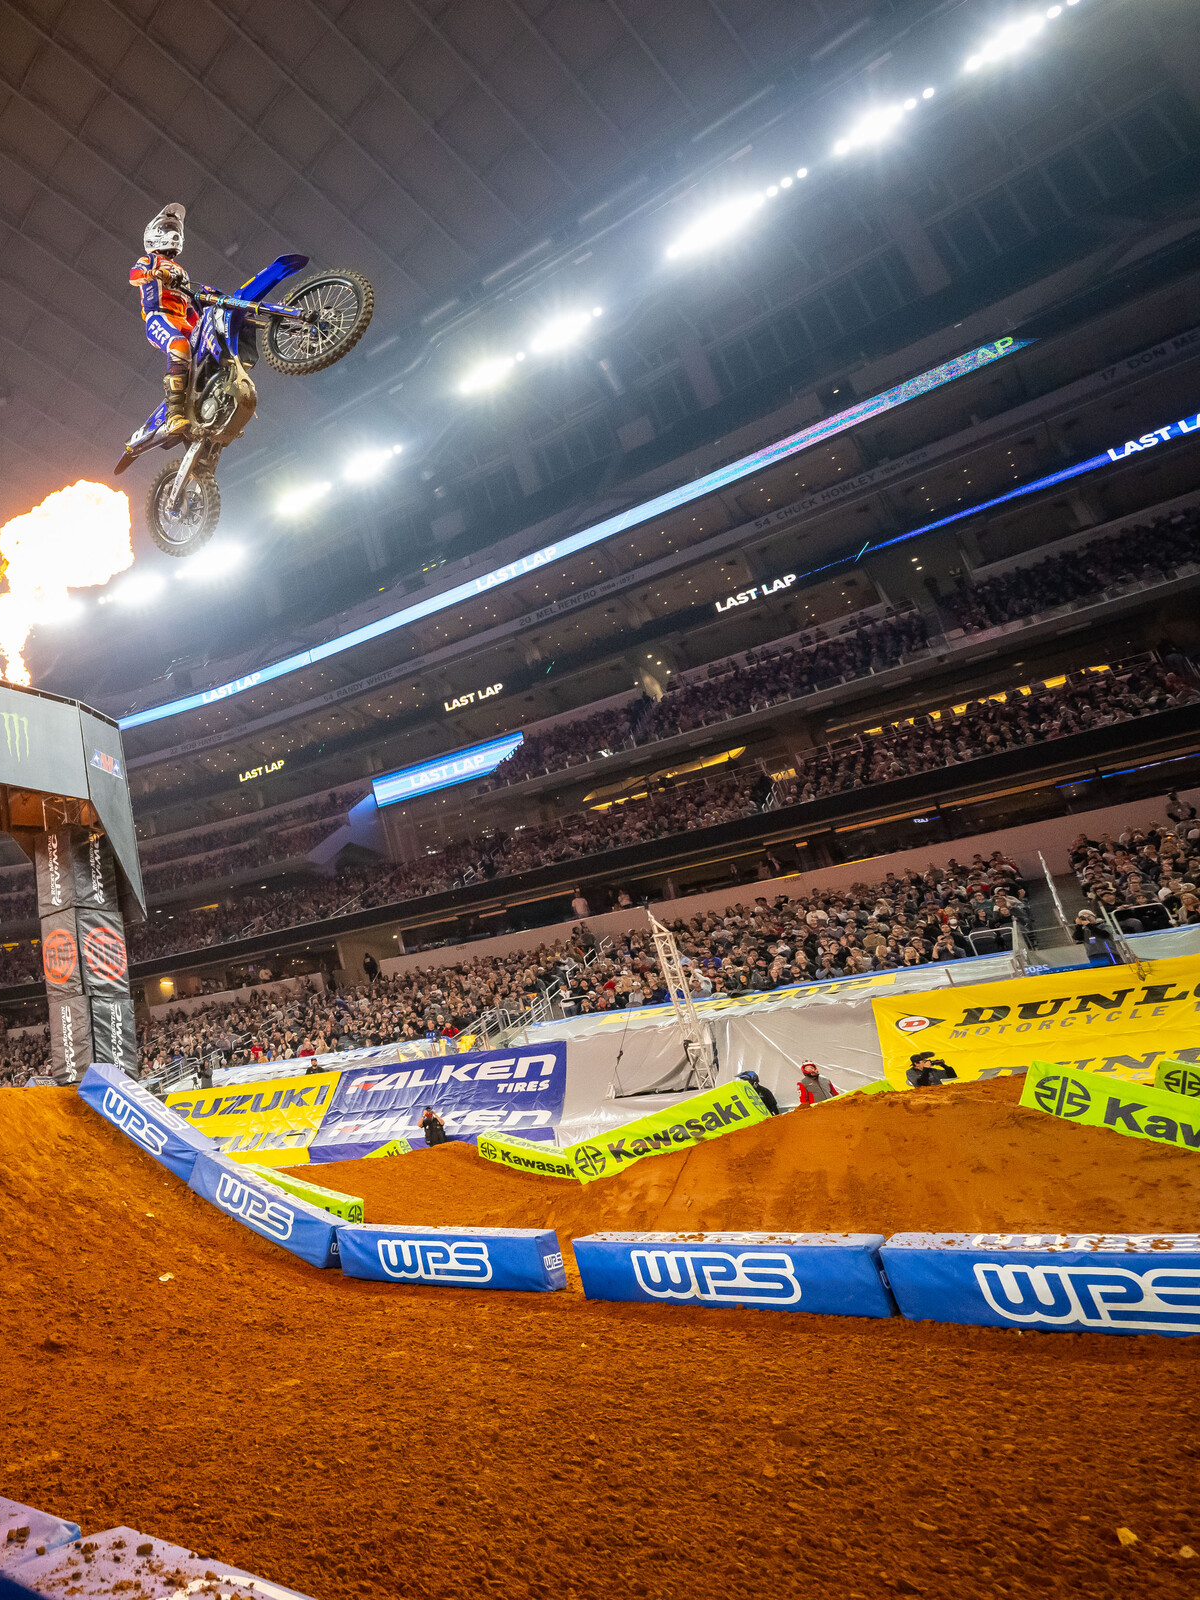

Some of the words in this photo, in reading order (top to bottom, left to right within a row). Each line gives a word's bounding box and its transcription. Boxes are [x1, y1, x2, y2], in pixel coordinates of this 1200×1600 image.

[1106, 425, 1172, 462] LAST
[775, 497, 815, 521] CHUCK
[820, 472, 876, 505] HOWLEY
[475, 560, 519, 592] LAST
[522, 546, 558, 571] LAP
[536, 607, 556, 621] MEL
[557, 590, 597, 611] RENFRO
[714, 588, 758, 613] LAST
[760, 573, 797, 597] LAP
[202, 683, 238, 705] LAST
[236, 672, 262, 692] LAP
[365, 670, 393, 686] WHITE
[443, 692, 476, 712] LAST
[477, 682, 504, 701] LAP
[90, 749, 123, 777] AMA
[238, 766, 263, 783] LAST
[264, 759, 285, 774] LAP
[409, 765, 450, 788] LAST
[452, 754, 485, 774] LAP
[949, 1005, 1169, 1040] MOTORCYCLE
[346, 1053, 557, 1095] FALKEN
[497, 1079, 551, 1094] TIRES
[119, 1079, 191, 1131] WPS
[169, 1085, 330, 1120] SUZUKI
[103, 1087, 169, 1156] WPS
[607, 1095, 751, 1163] Kawasaki
[216, 1172, 295, 1241] WPS
[377, 1239, 493, 1283] WPS
[543, 1252, 564, 1272] WPS
[630, 1250, 802, 1305] WPS
